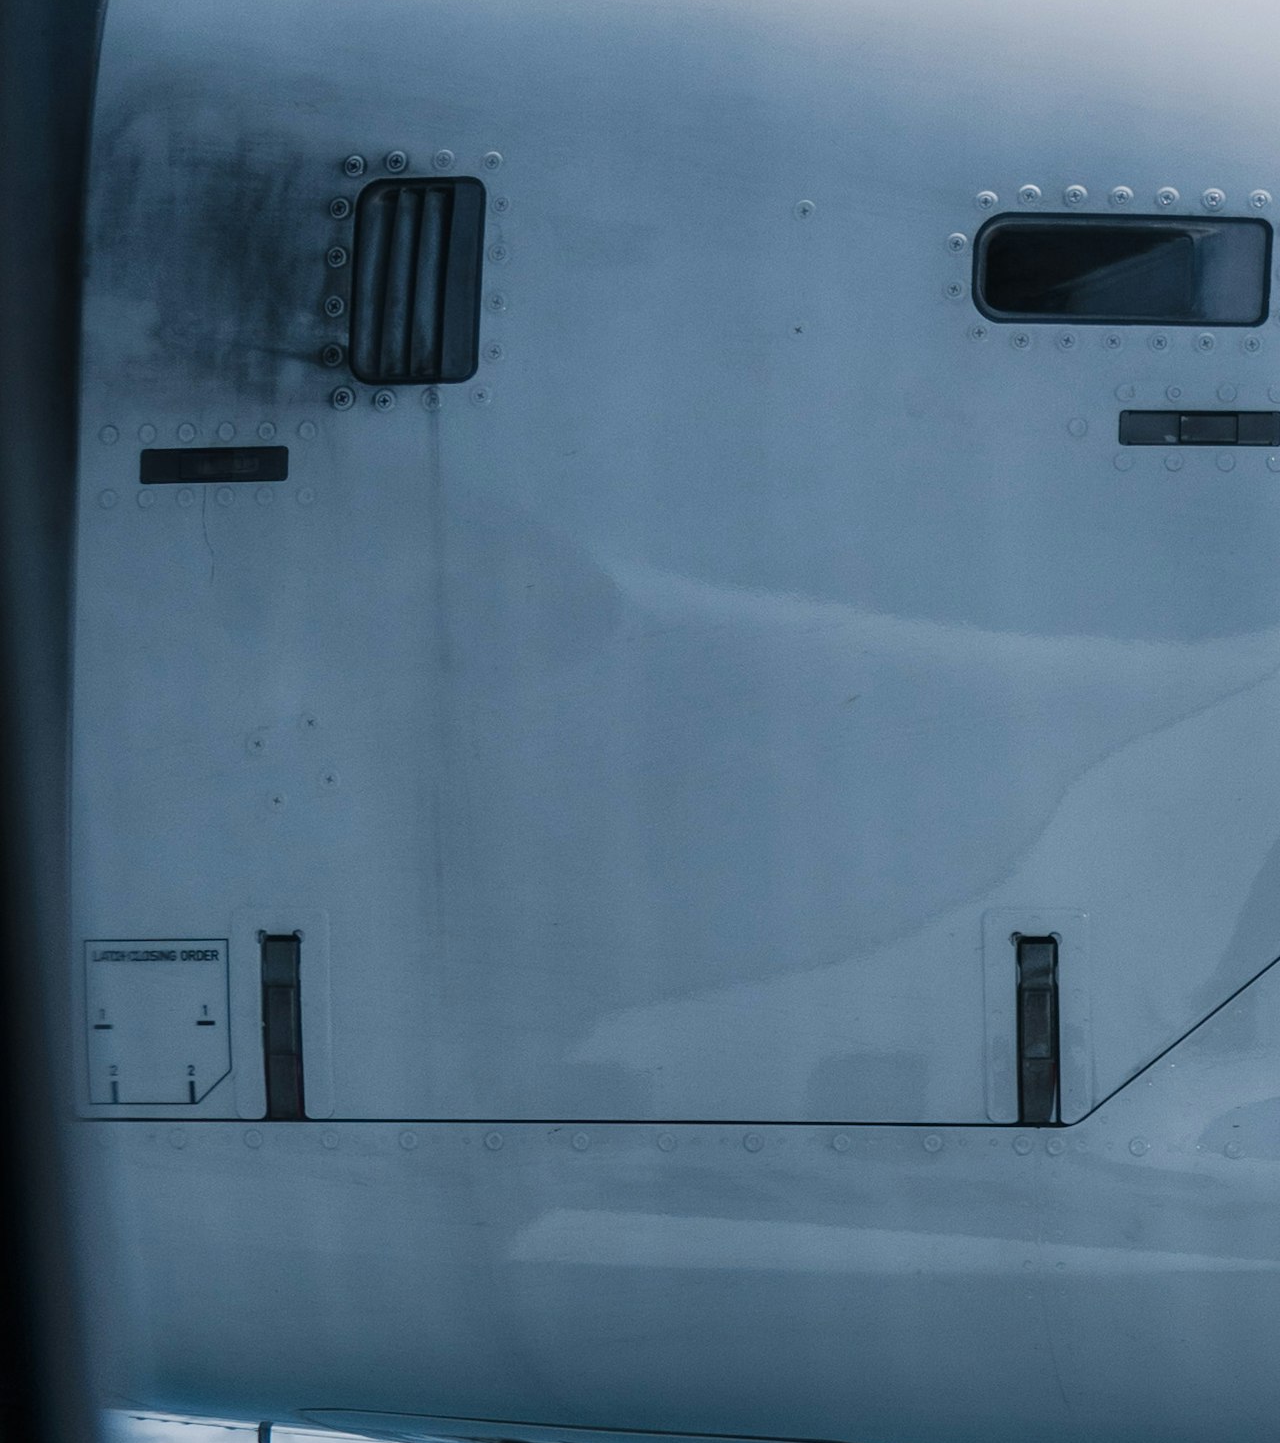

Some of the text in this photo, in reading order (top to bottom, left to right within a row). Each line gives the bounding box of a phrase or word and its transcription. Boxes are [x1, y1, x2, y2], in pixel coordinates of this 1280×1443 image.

[128, 950, 177, 962] CLOSING
[181, 949, 219, 962] ORDER
[187, 1064, 196, 1076] 2
